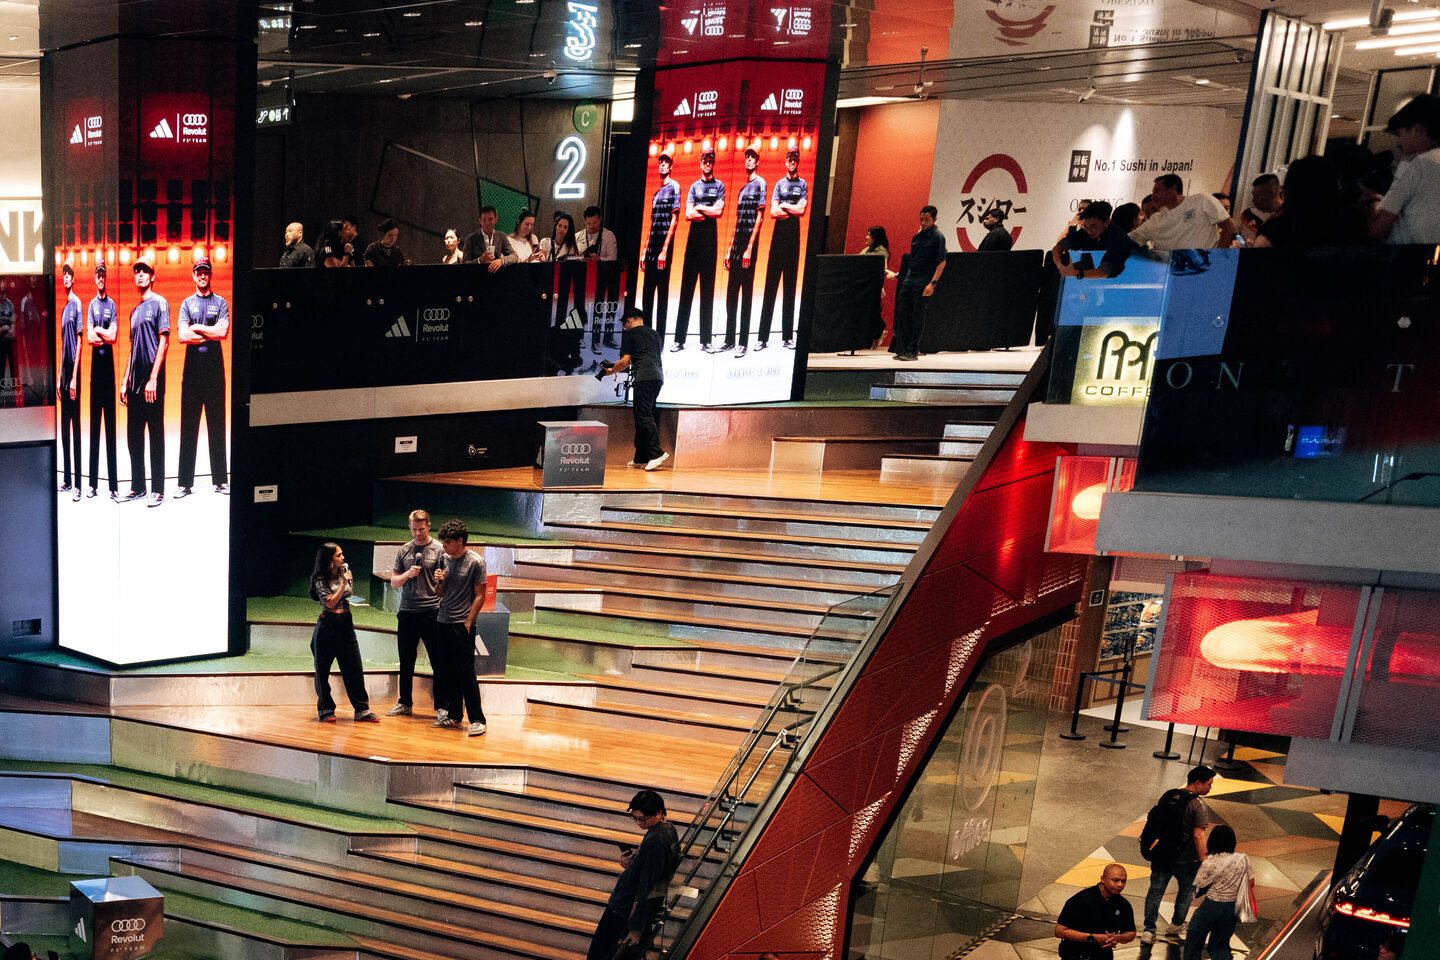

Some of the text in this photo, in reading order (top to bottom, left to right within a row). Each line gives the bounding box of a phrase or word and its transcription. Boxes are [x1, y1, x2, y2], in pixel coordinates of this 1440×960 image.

[183, 127, 207, 135] Revolut
[554, 135, 588, 199] 2
[1094, 159, 1193, 173] No.1 Sushi in Japan!
[422, 324, 448, 332] Revolut
[111, 934, 144, 944] Revolut
